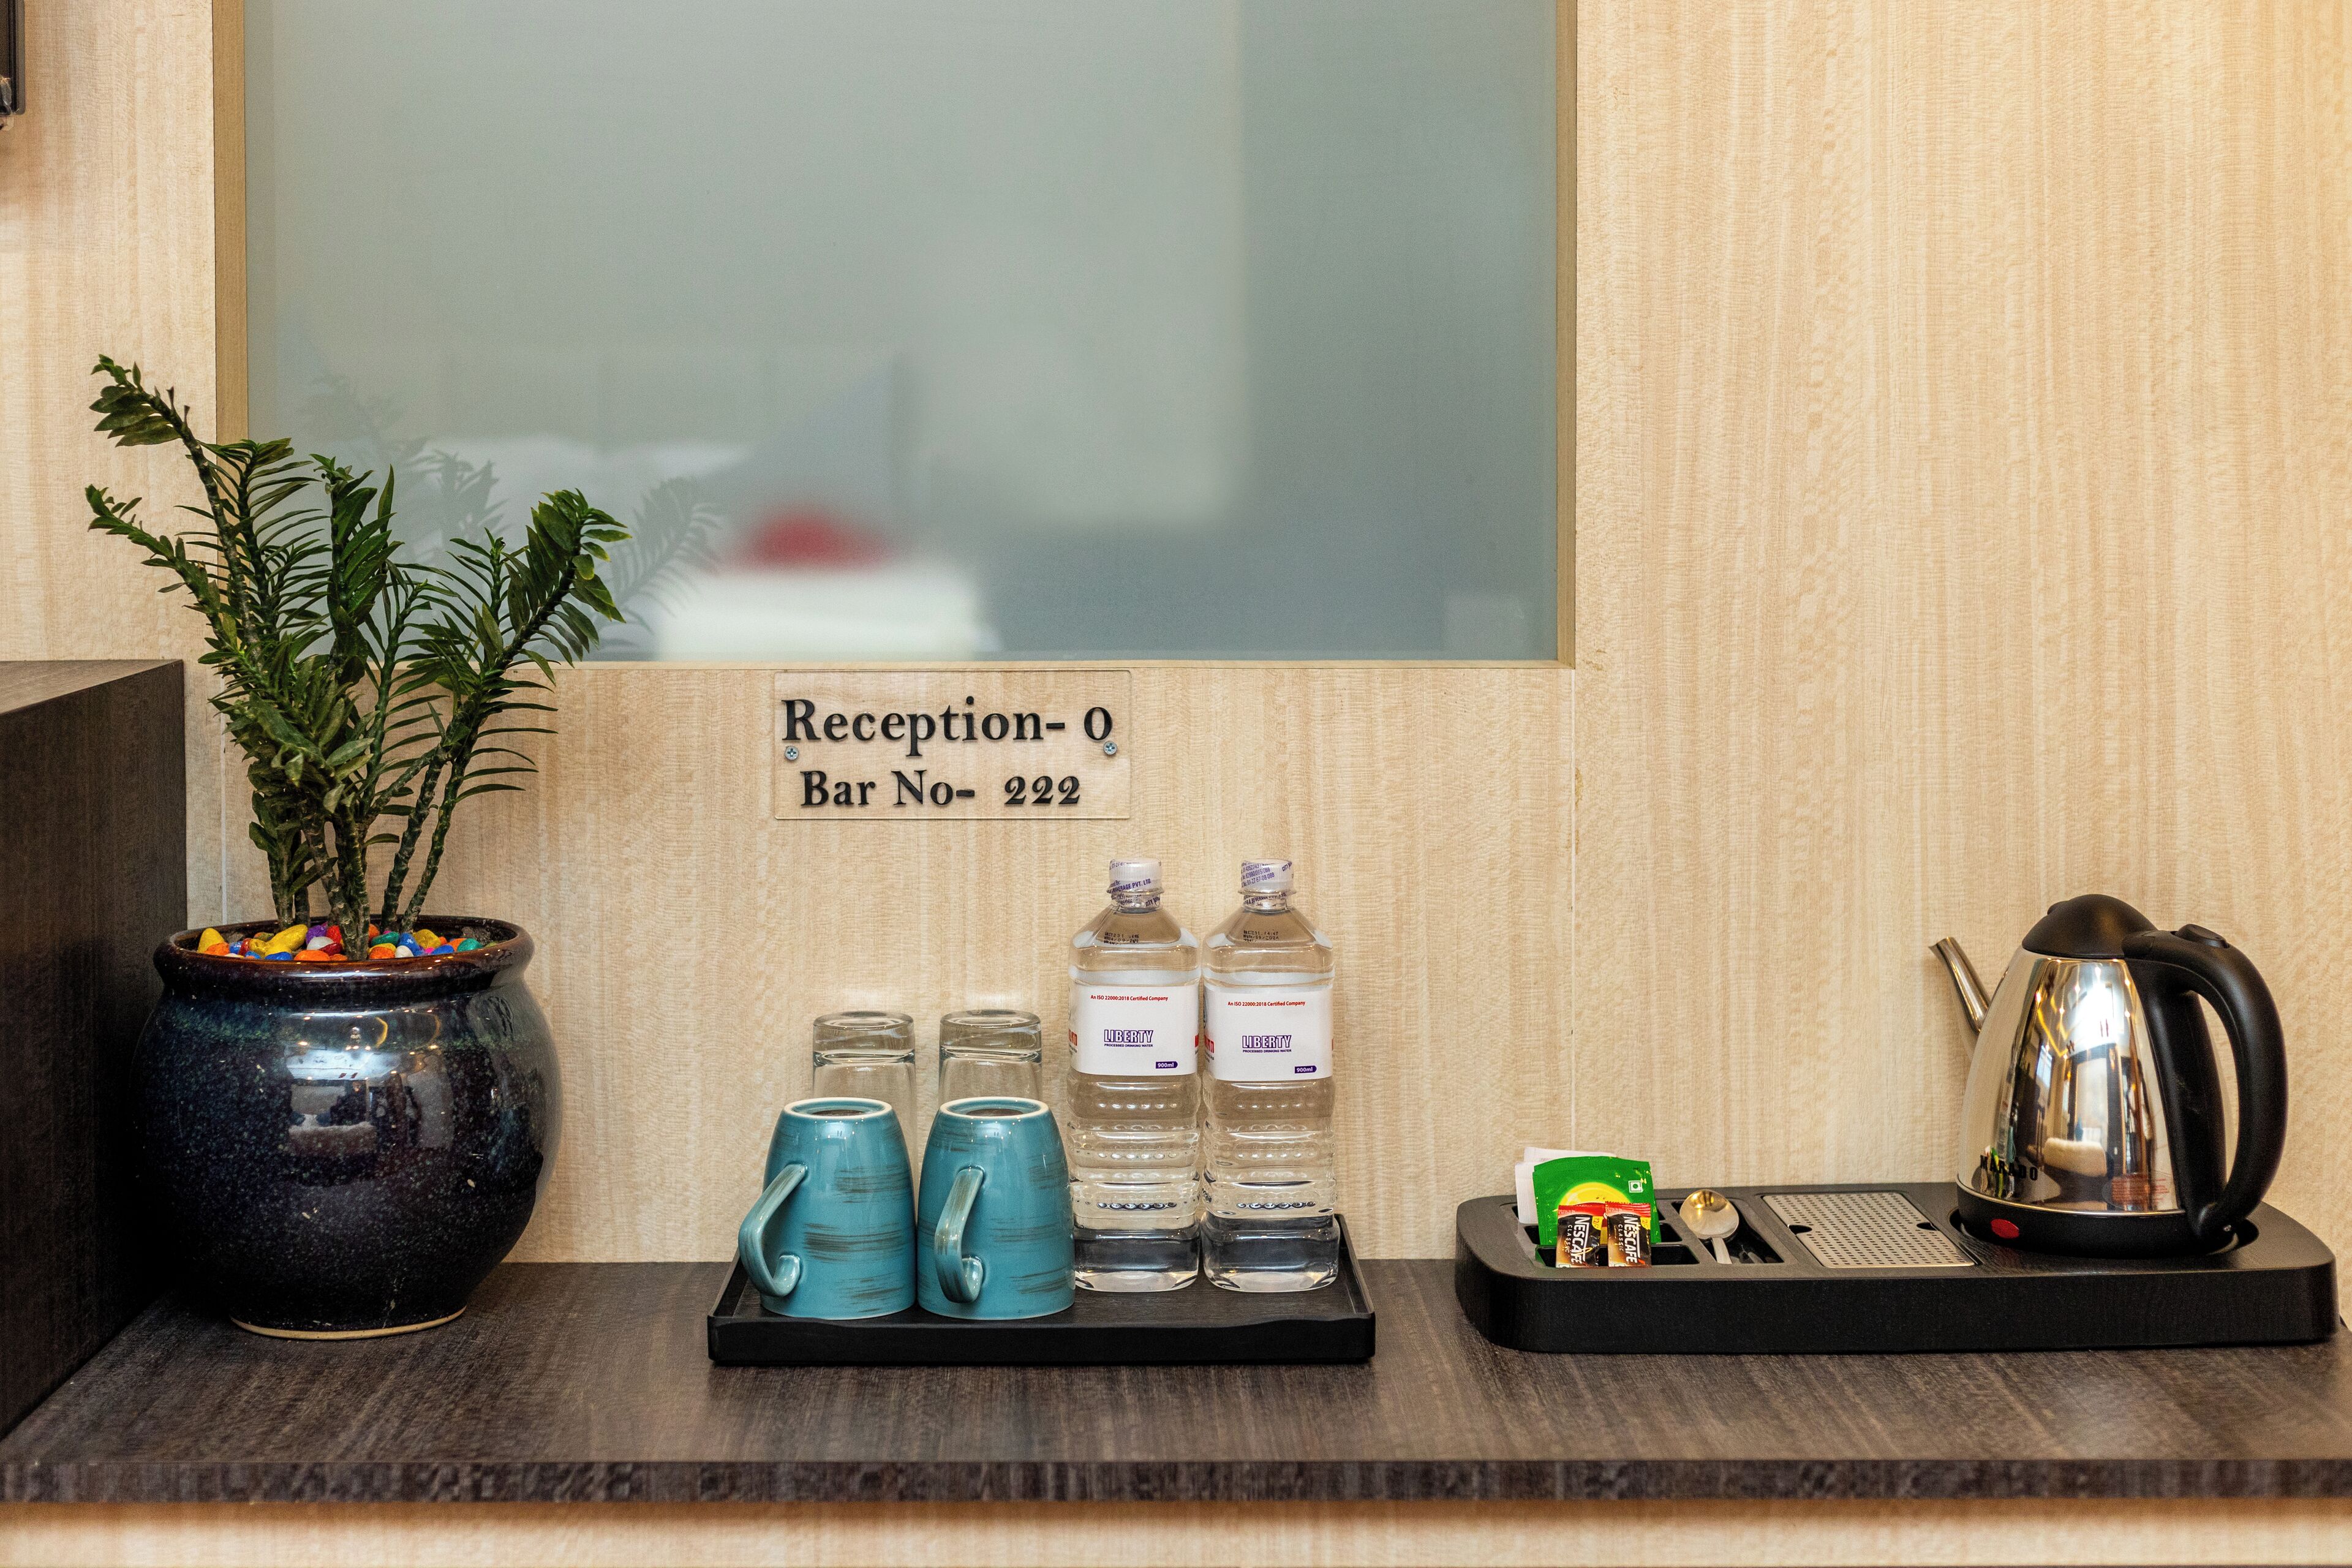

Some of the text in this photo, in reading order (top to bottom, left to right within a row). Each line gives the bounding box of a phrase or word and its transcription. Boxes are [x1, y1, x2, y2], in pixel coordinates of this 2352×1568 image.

[781, 695, 1066, 758] Reception-
[800, 769, 1081, 808] Bar No- 222
[1104, 1029, 1154, 1043] LIBERTY
[1242, 1035, 1292, 1049] LIBERTY
